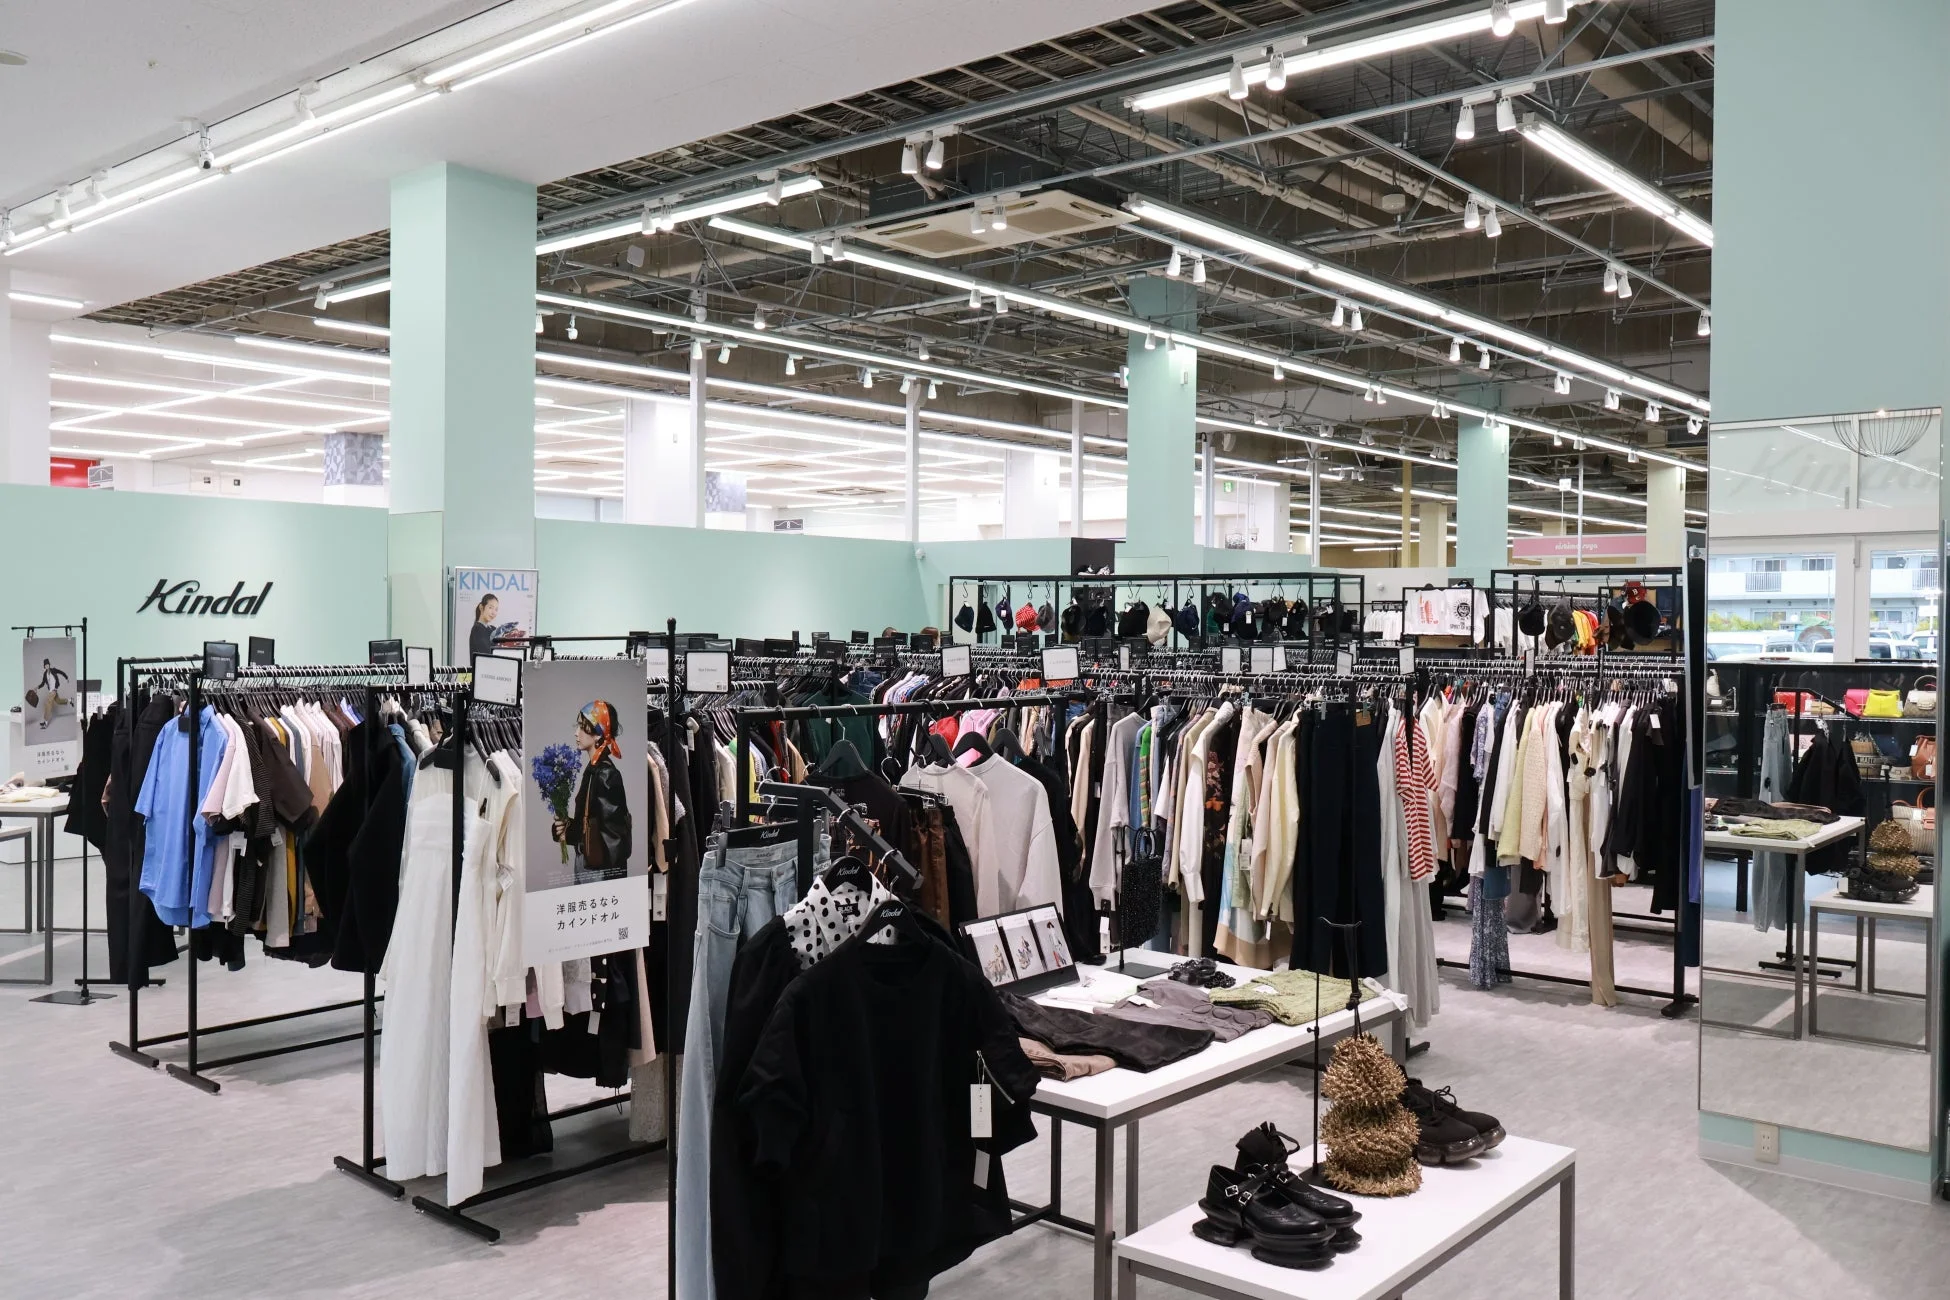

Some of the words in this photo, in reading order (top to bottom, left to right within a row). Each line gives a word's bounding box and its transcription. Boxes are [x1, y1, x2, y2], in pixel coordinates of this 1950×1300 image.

[459, 571, 529, 591] KINDAL
[136, 579, 274, 615] Kindal
[760, 828, 780, 839] Kindal
[837, 866, 860, 876] Kindal
[556, 895, 619, 915] 洋服売るなら
[881, 908, 903, 917] Kindal
[557, 911, 620, 931] カインドオル
